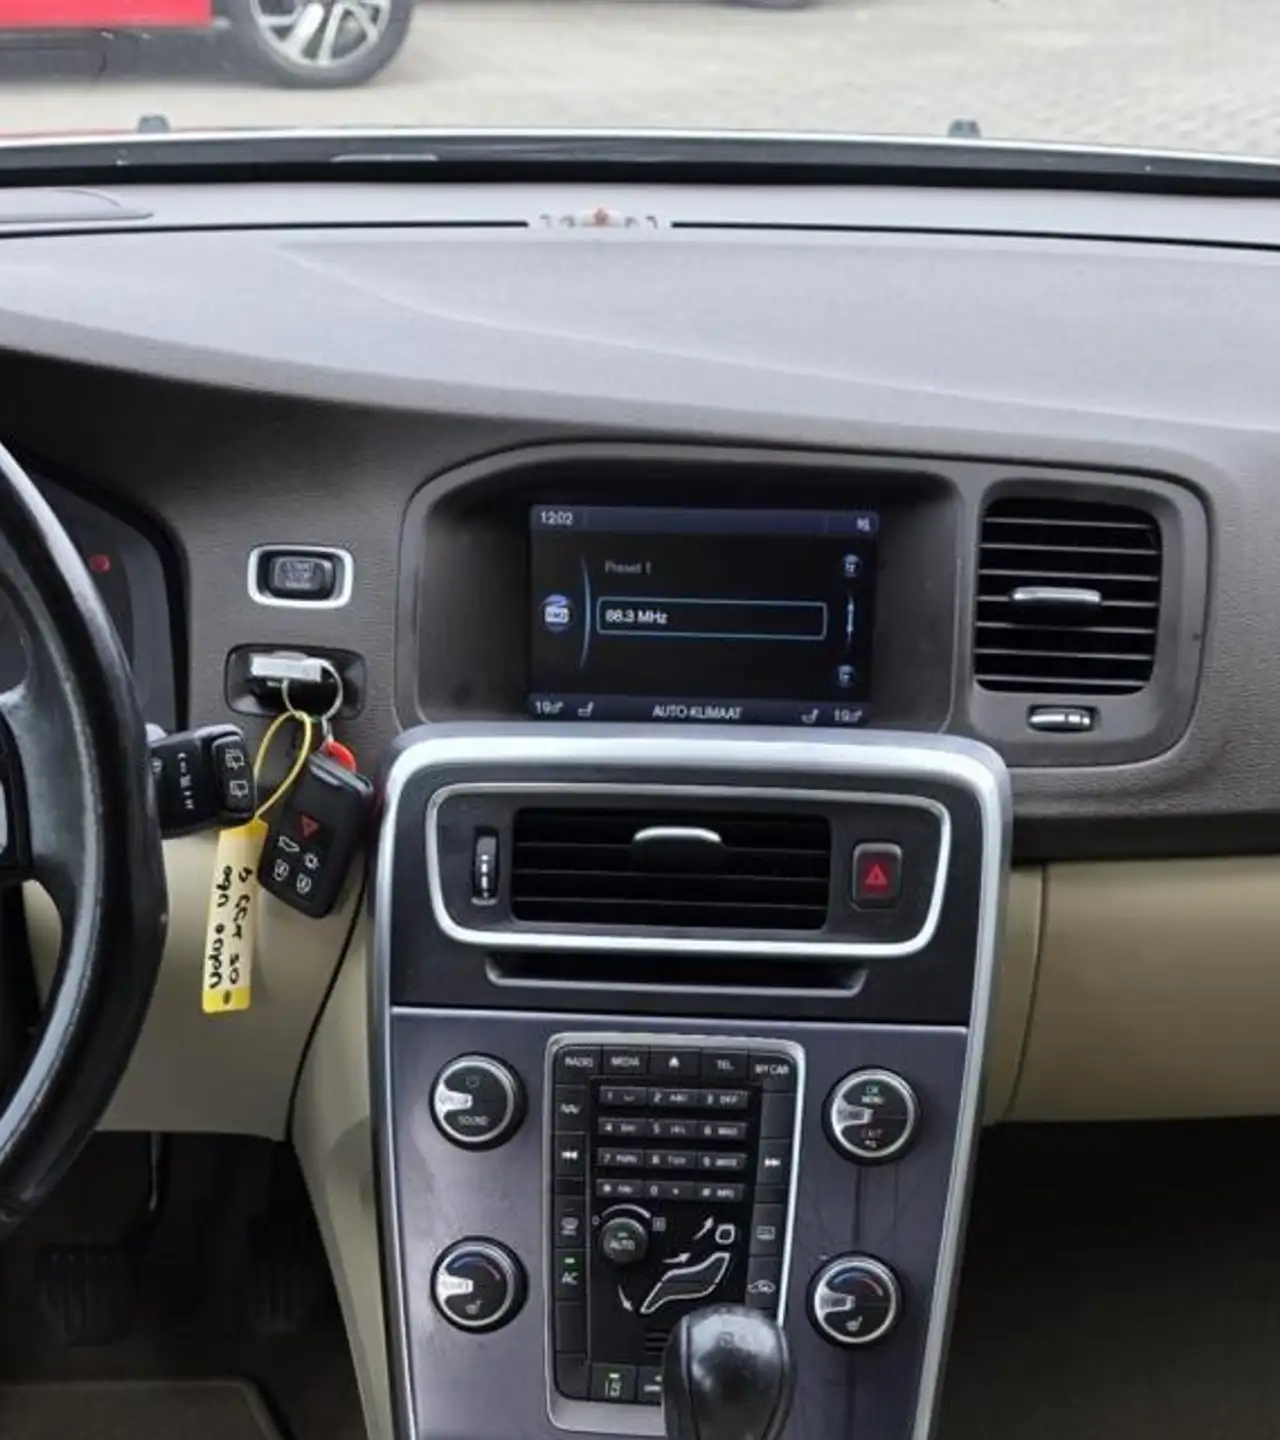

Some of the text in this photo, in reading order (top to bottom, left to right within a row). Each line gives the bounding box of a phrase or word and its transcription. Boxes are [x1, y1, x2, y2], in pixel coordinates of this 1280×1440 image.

[637, 609, 668, 625] MHz
[564, 1056, 594, 1068] RADIO
[610, 1055, 640, 1067] MEDIA
[770, 1063, 790, 1075] CAR
[457, 1115, 490, 1126] SOUND
[562, 1272, 579, 1287] AC
